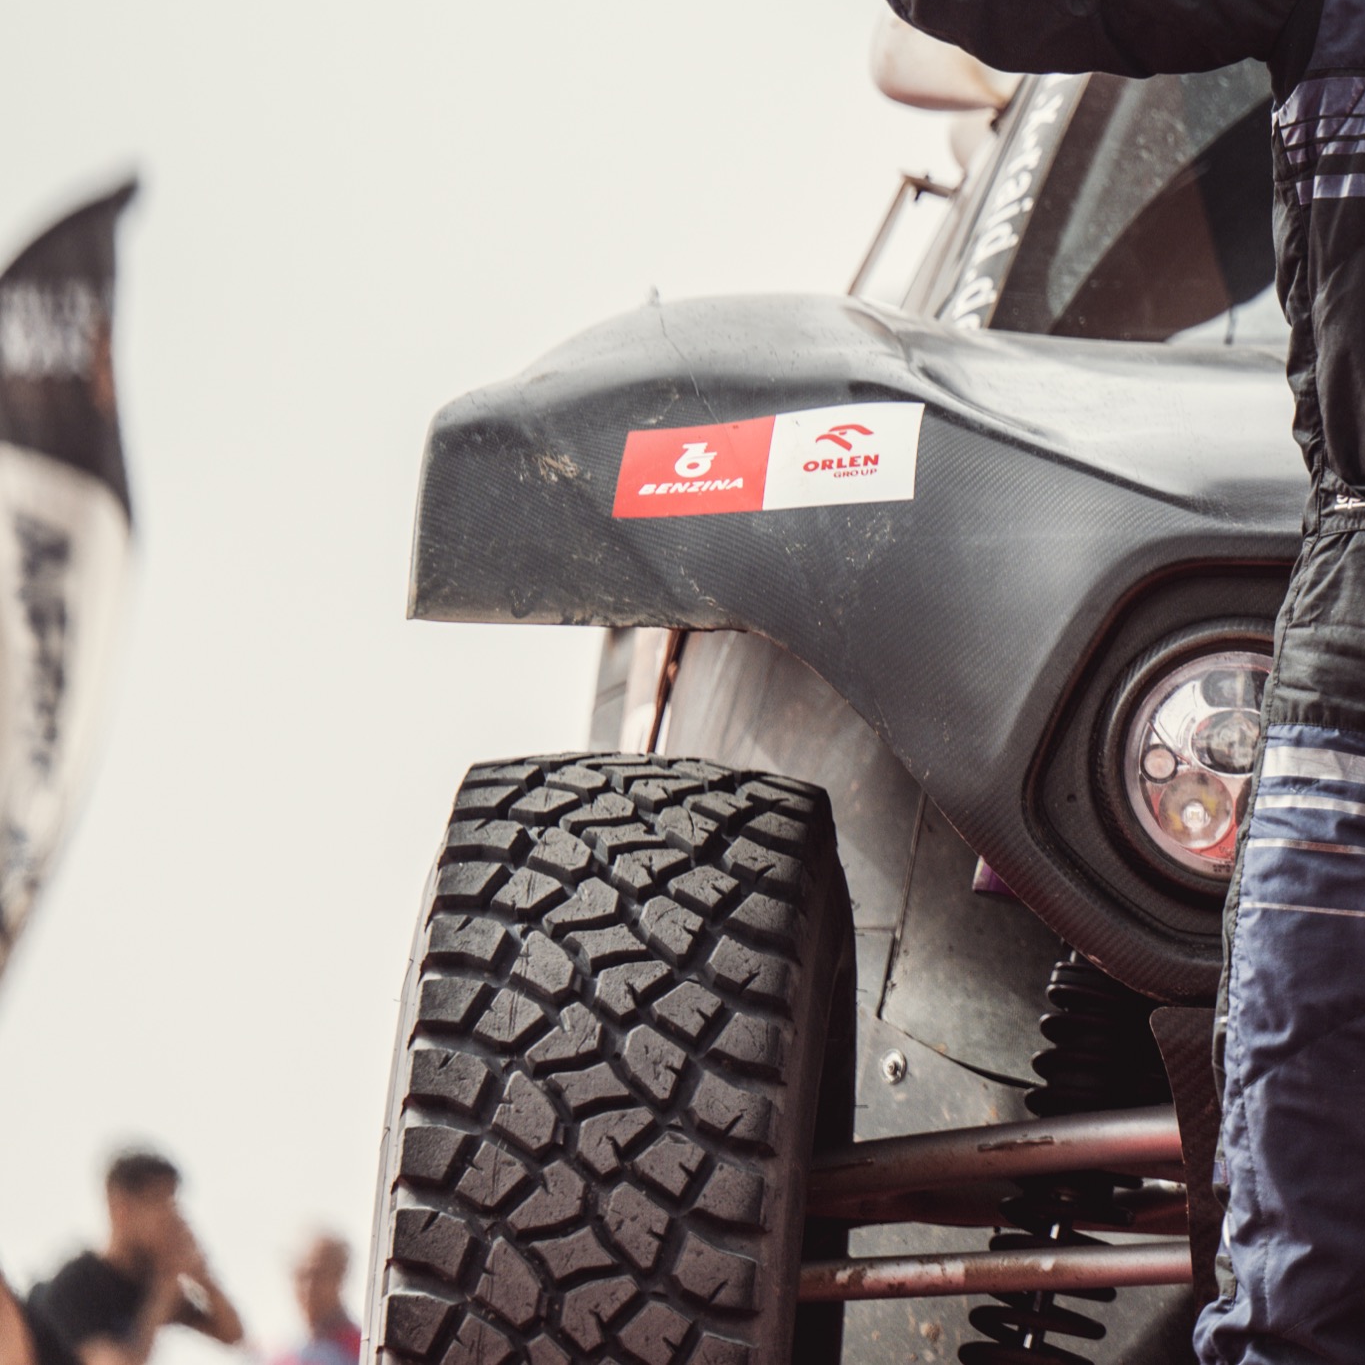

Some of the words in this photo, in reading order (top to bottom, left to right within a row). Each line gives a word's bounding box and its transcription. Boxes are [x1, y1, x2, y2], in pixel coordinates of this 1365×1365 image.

[803, 454, 880, 473] ORLEN
[833, 468, 878, 478] GROUP
[638, 477, 744, 495] BENZINA
